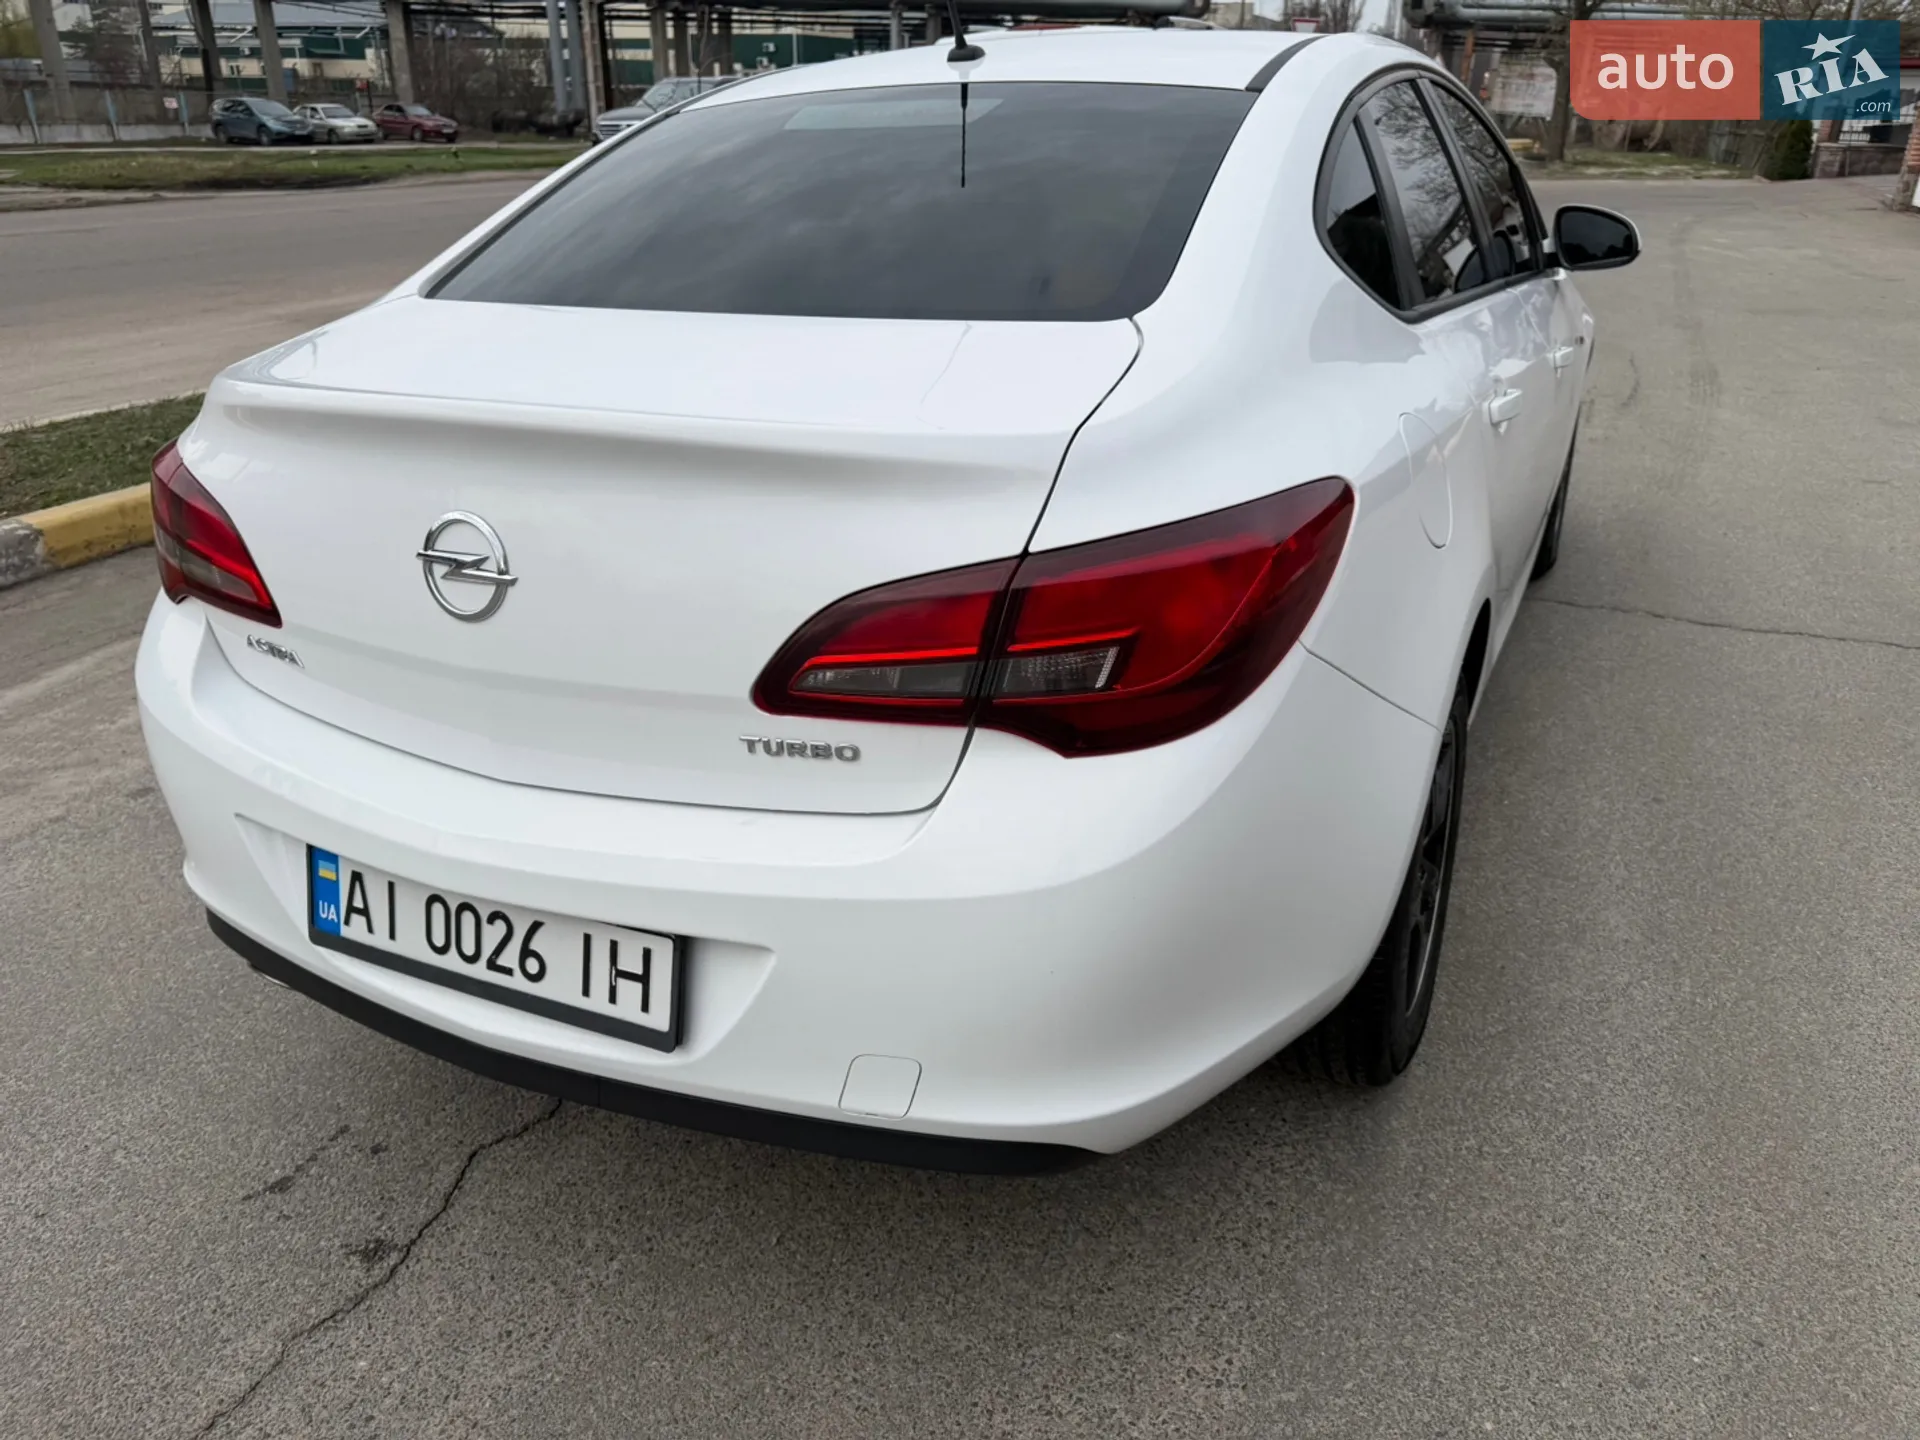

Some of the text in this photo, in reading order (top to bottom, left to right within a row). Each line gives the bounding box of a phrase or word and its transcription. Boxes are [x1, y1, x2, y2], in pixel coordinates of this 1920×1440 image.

[739, 735, 861, 762] TURBO
[318, 899, 338, 923] UA
[343, 869, 652, 1014] AI 0026 IH
